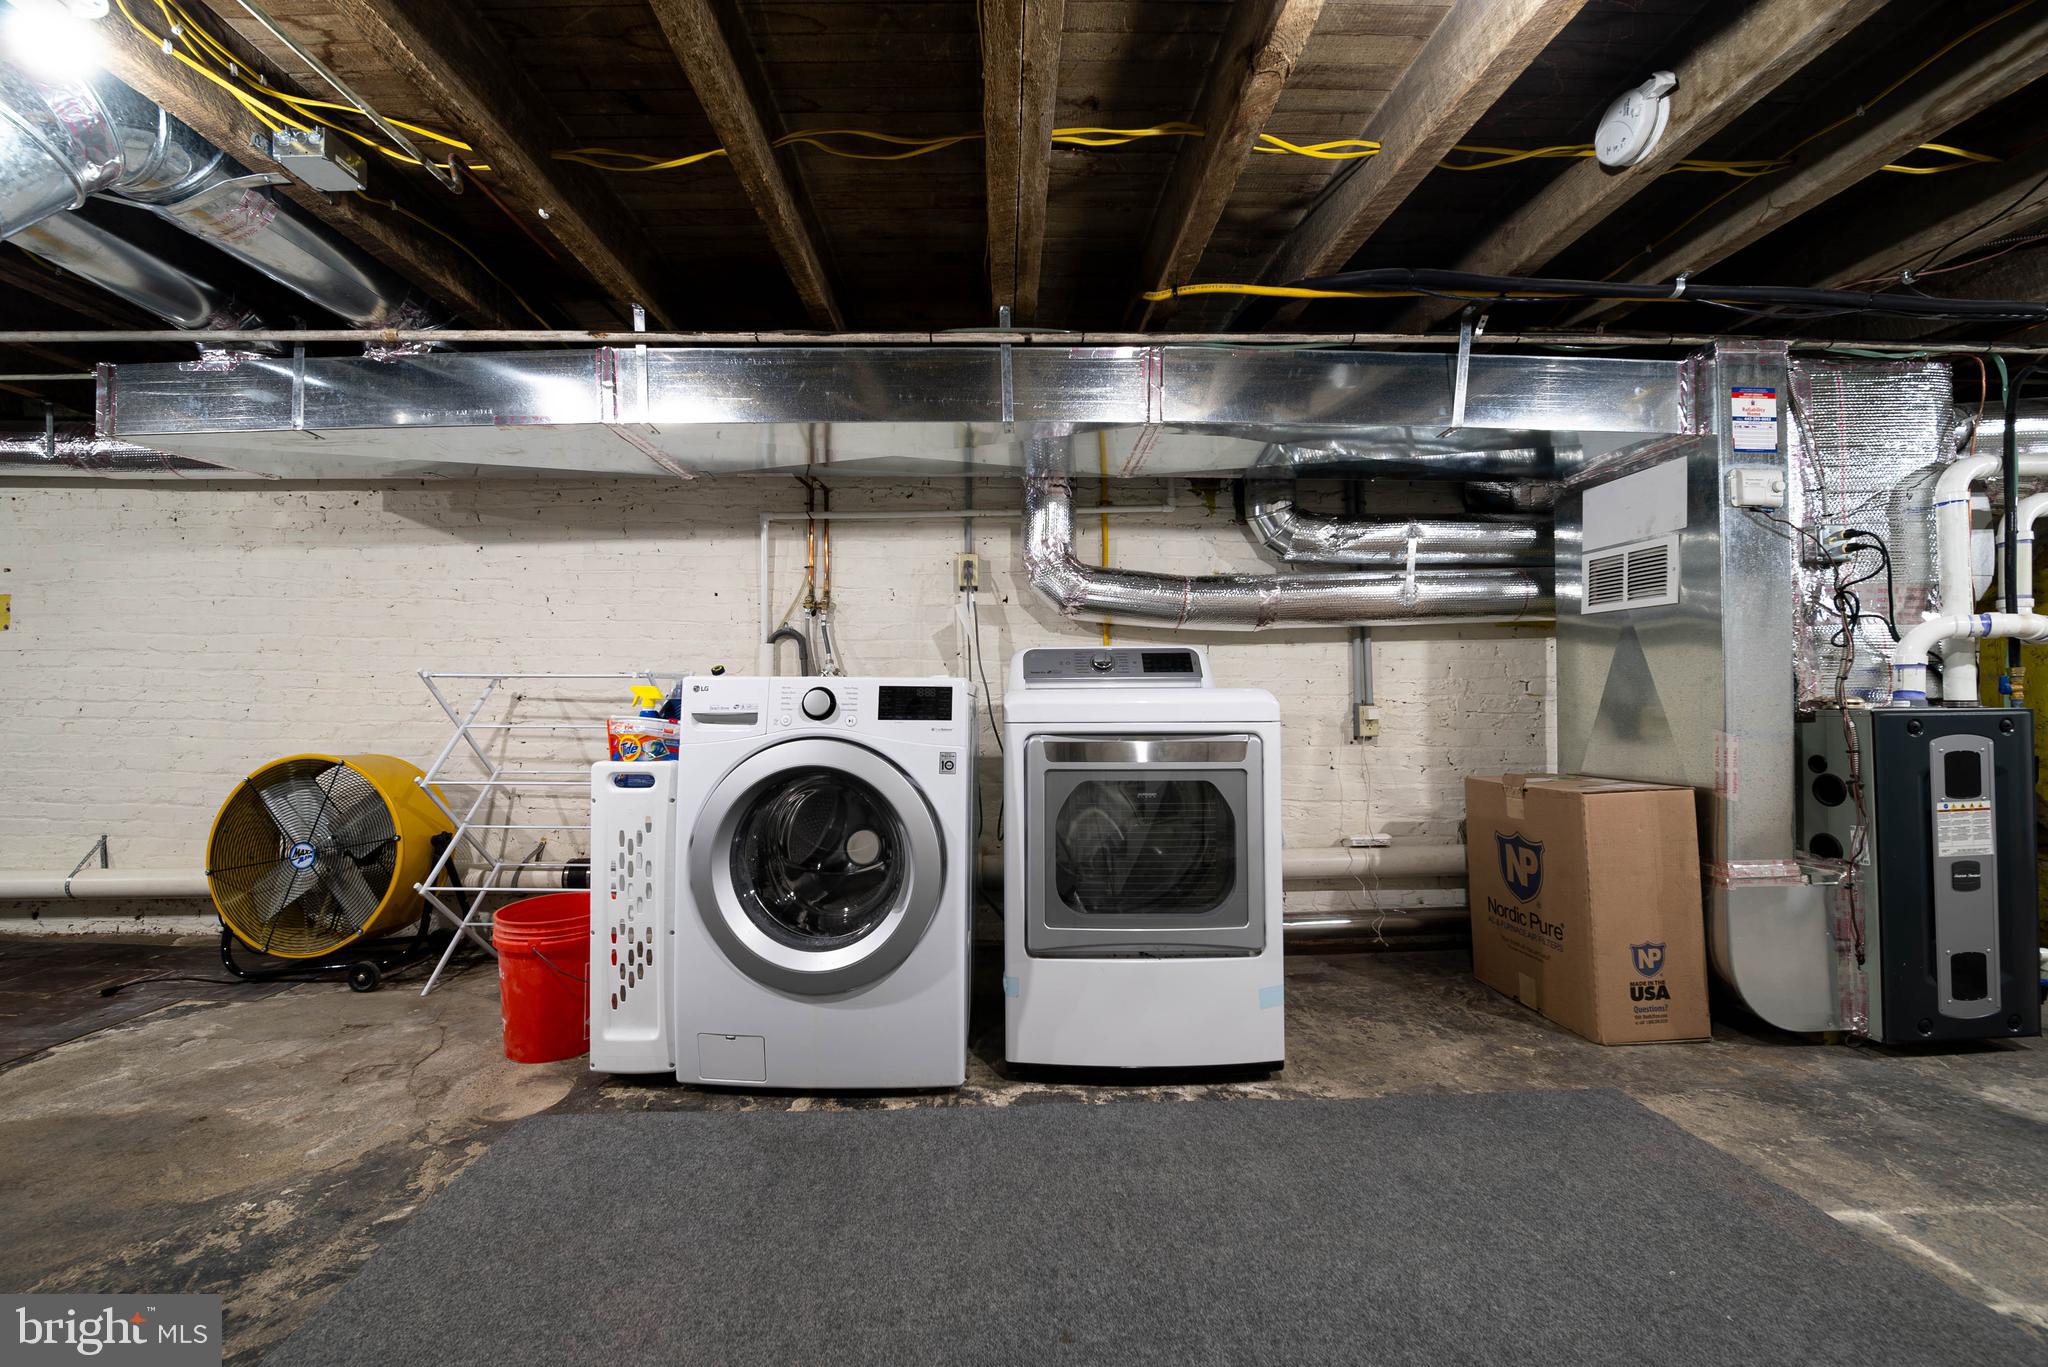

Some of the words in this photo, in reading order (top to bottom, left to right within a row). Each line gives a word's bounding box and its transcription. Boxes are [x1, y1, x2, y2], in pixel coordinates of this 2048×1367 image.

[620, 741, 639, 758] Tide
[1504, 843, 1540, 888] NP
[1487, 895, 1528, 927] Nordic
[1529, 911, 1565, 941] Pure
[1637, 948, 1663, 969] NP
[1630, 985, 1671, 1002] USA
[1633, 1004, 1669, 1014] Questions?
